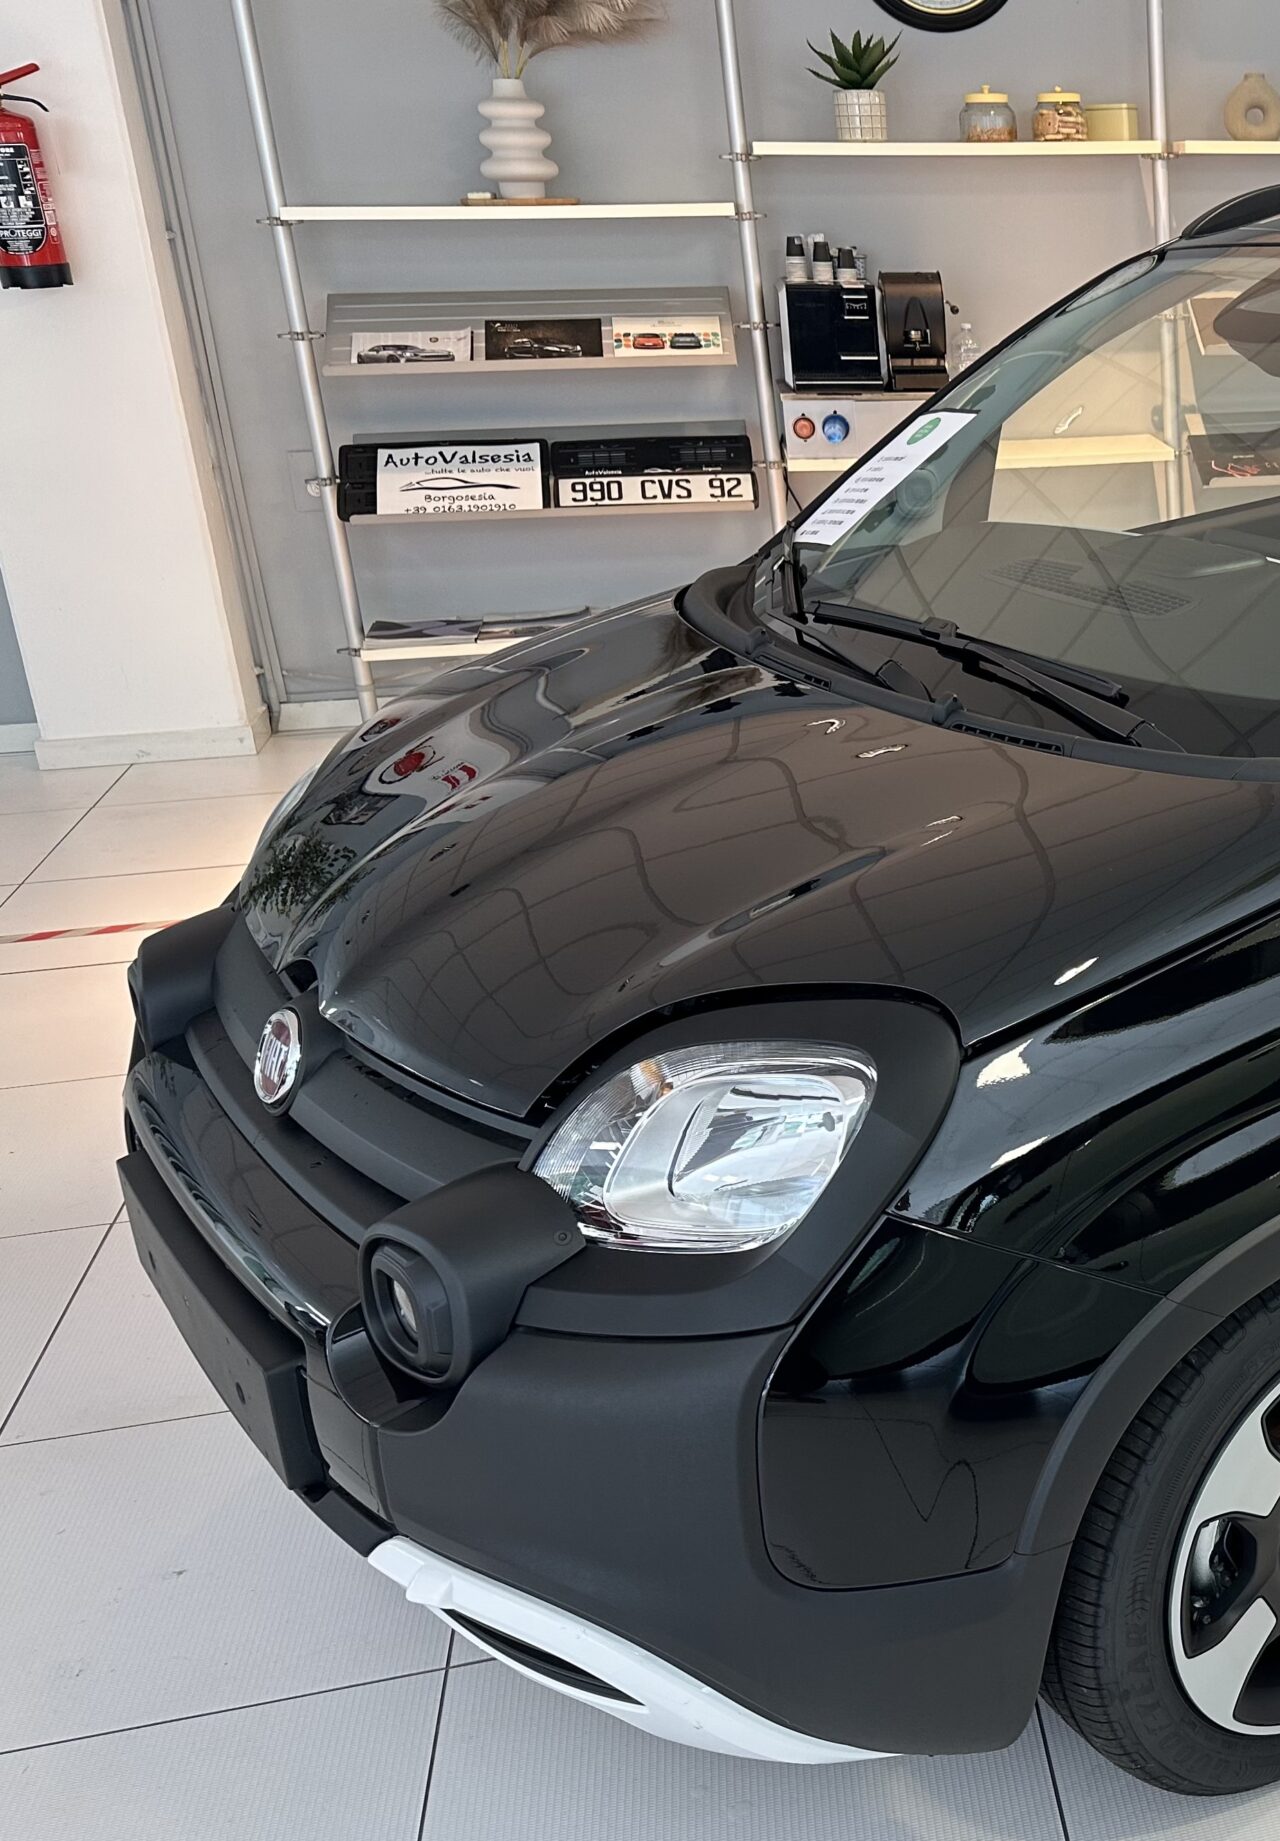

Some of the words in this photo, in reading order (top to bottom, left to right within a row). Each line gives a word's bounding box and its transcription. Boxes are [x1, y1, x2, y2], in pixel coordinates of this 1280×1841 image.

[384, 450, 534, 468] AutoValsesia
[424, 493, 496, 504] Borgosesia
[571, 481, 623, 502] 990
[641, 479, 692, 500] CVS
[708, 477, 743, 498] 92
[404, 506, 427, 514] +39
[433, 504, 517, 514] 0163.1901910
[261, 1032, 289, 1085] FIAT
